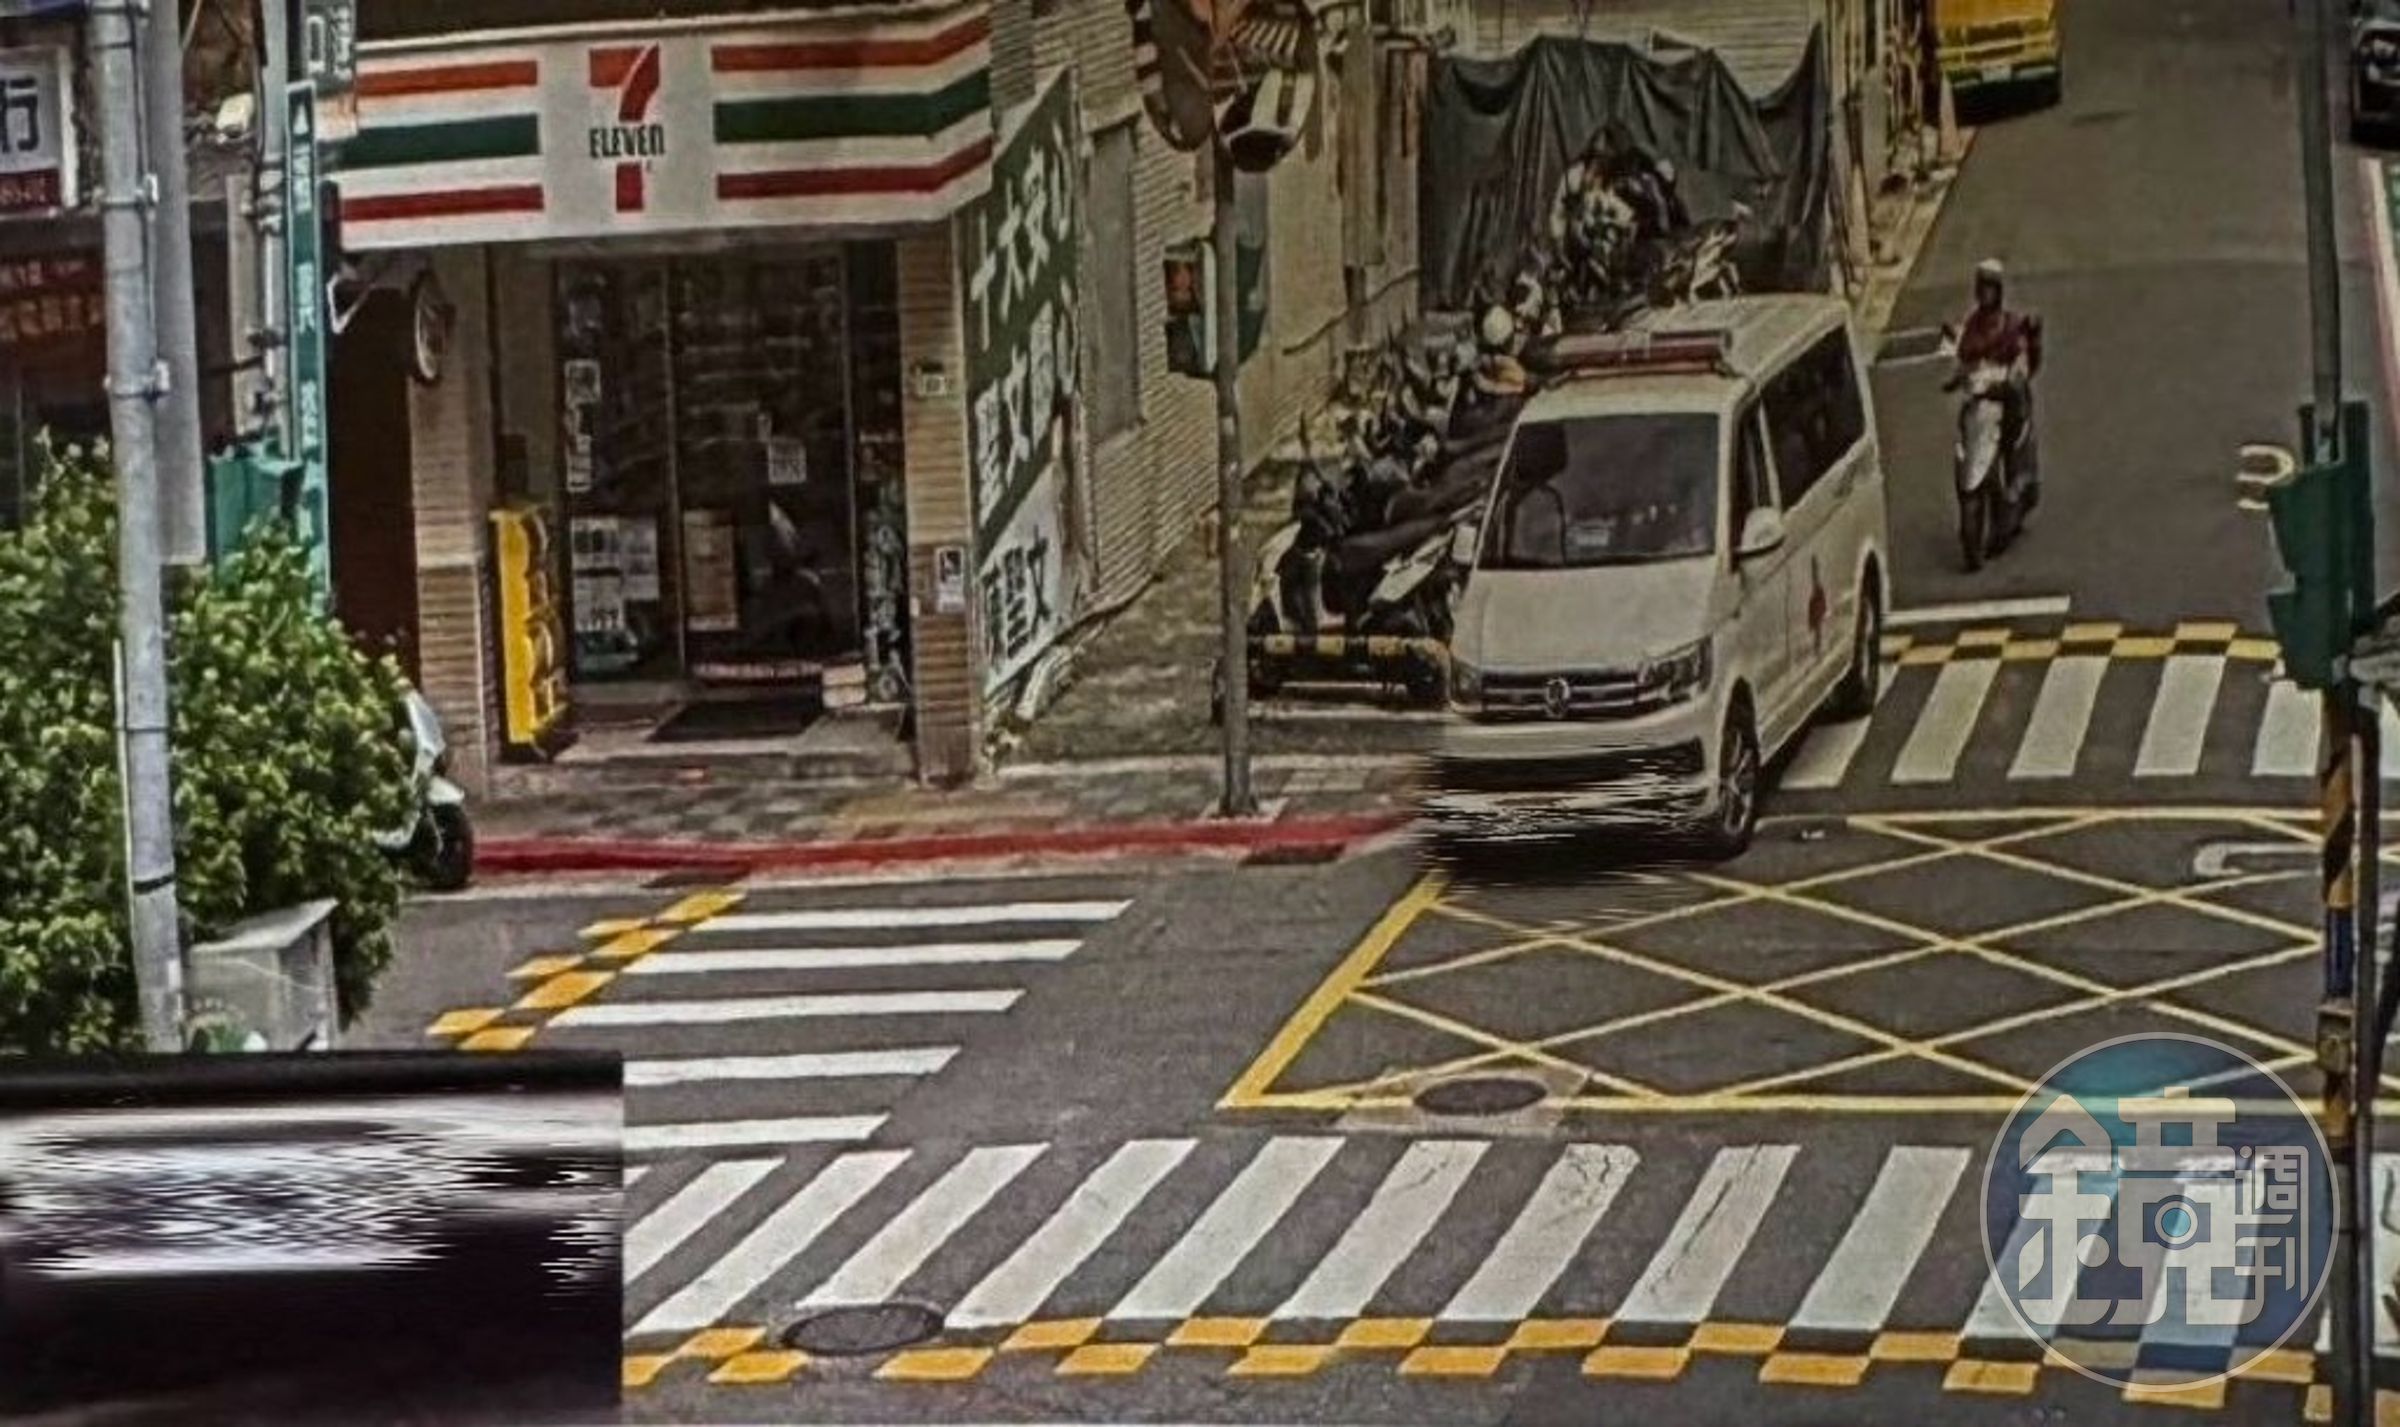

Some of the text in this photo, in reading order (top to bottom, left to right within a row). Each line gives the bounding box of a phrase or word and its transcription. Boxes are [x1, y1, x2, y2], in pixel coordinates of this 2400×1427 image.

[588, 42, 661, 214] 7
[971, 120, 1070, 354] 十大安心
